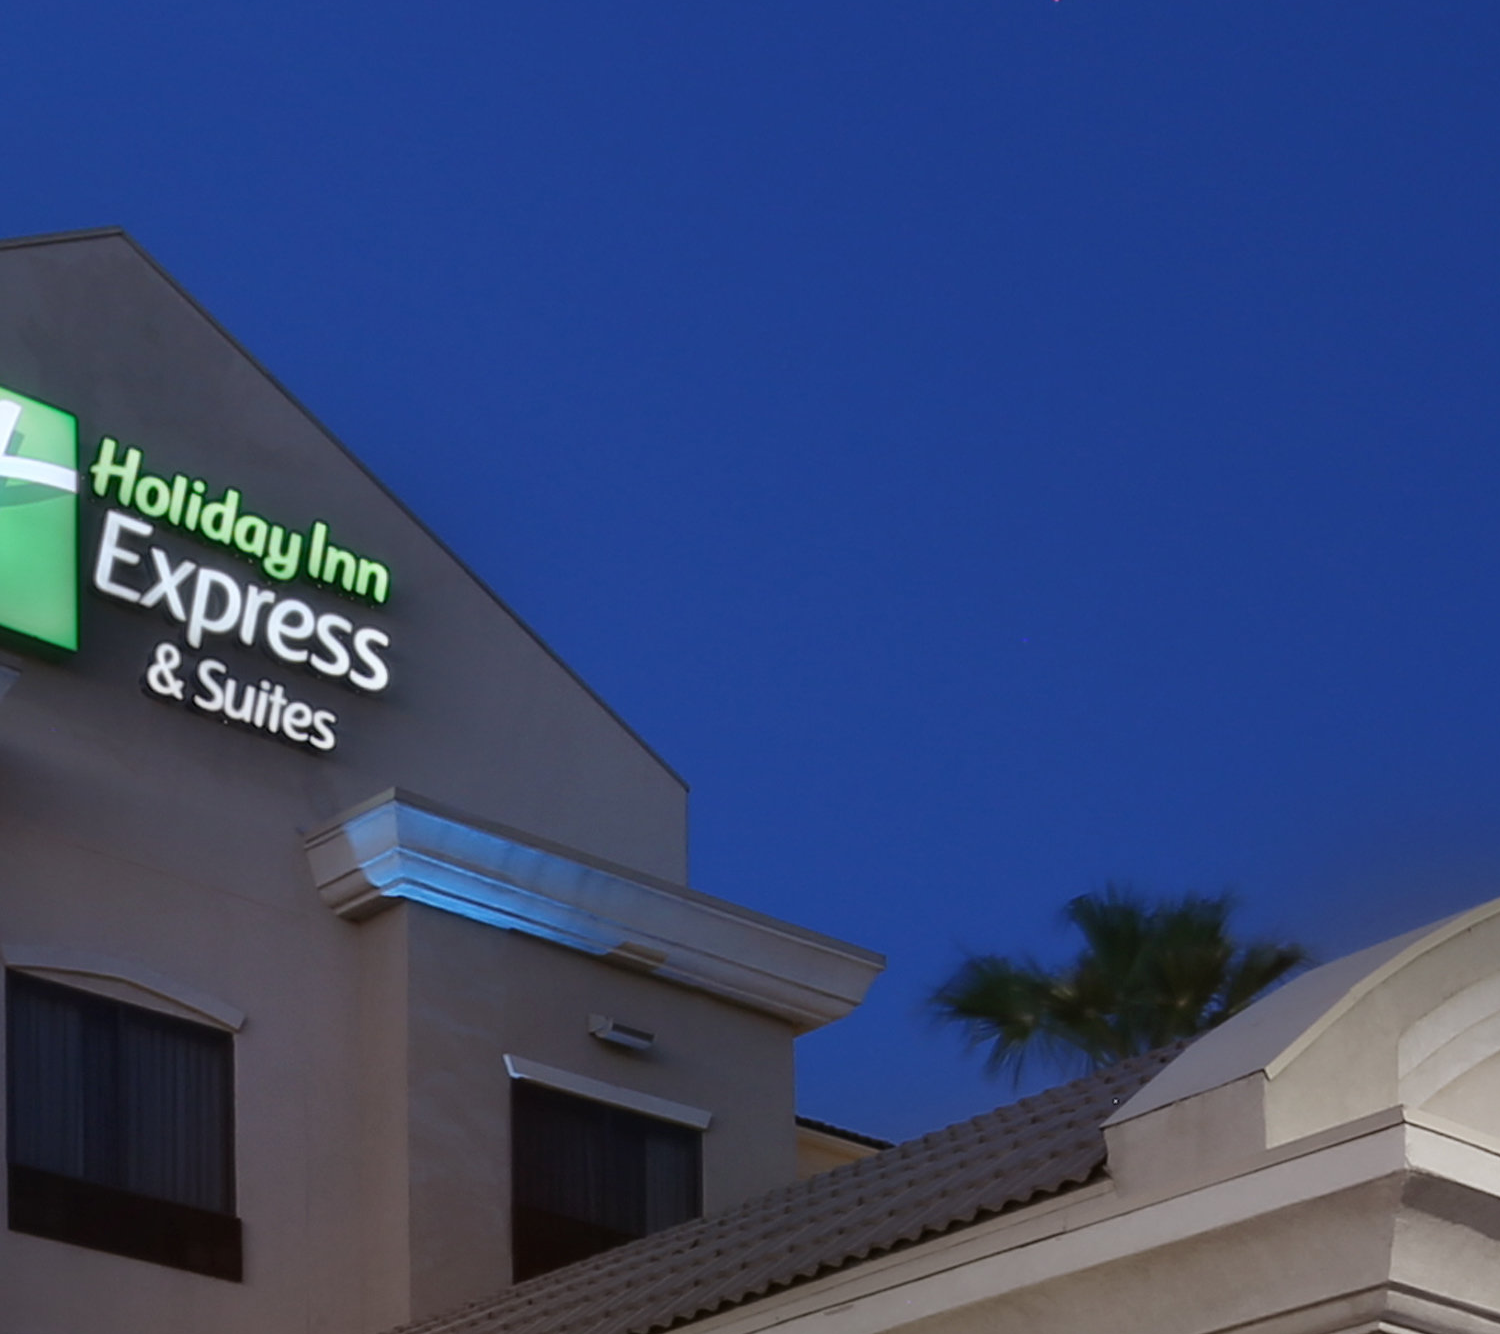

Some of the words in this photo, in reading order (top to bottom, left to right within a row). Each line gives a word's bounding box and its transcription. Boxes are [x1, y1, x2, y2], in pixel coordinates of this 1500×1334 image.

[90, 437, 303, 580] Holiday
[307, 521, 390, 604] Inn
[94, 509, 390, 691] Express
[146, 642, 184, 700] &
[193, 659, 337, 750] Suites
